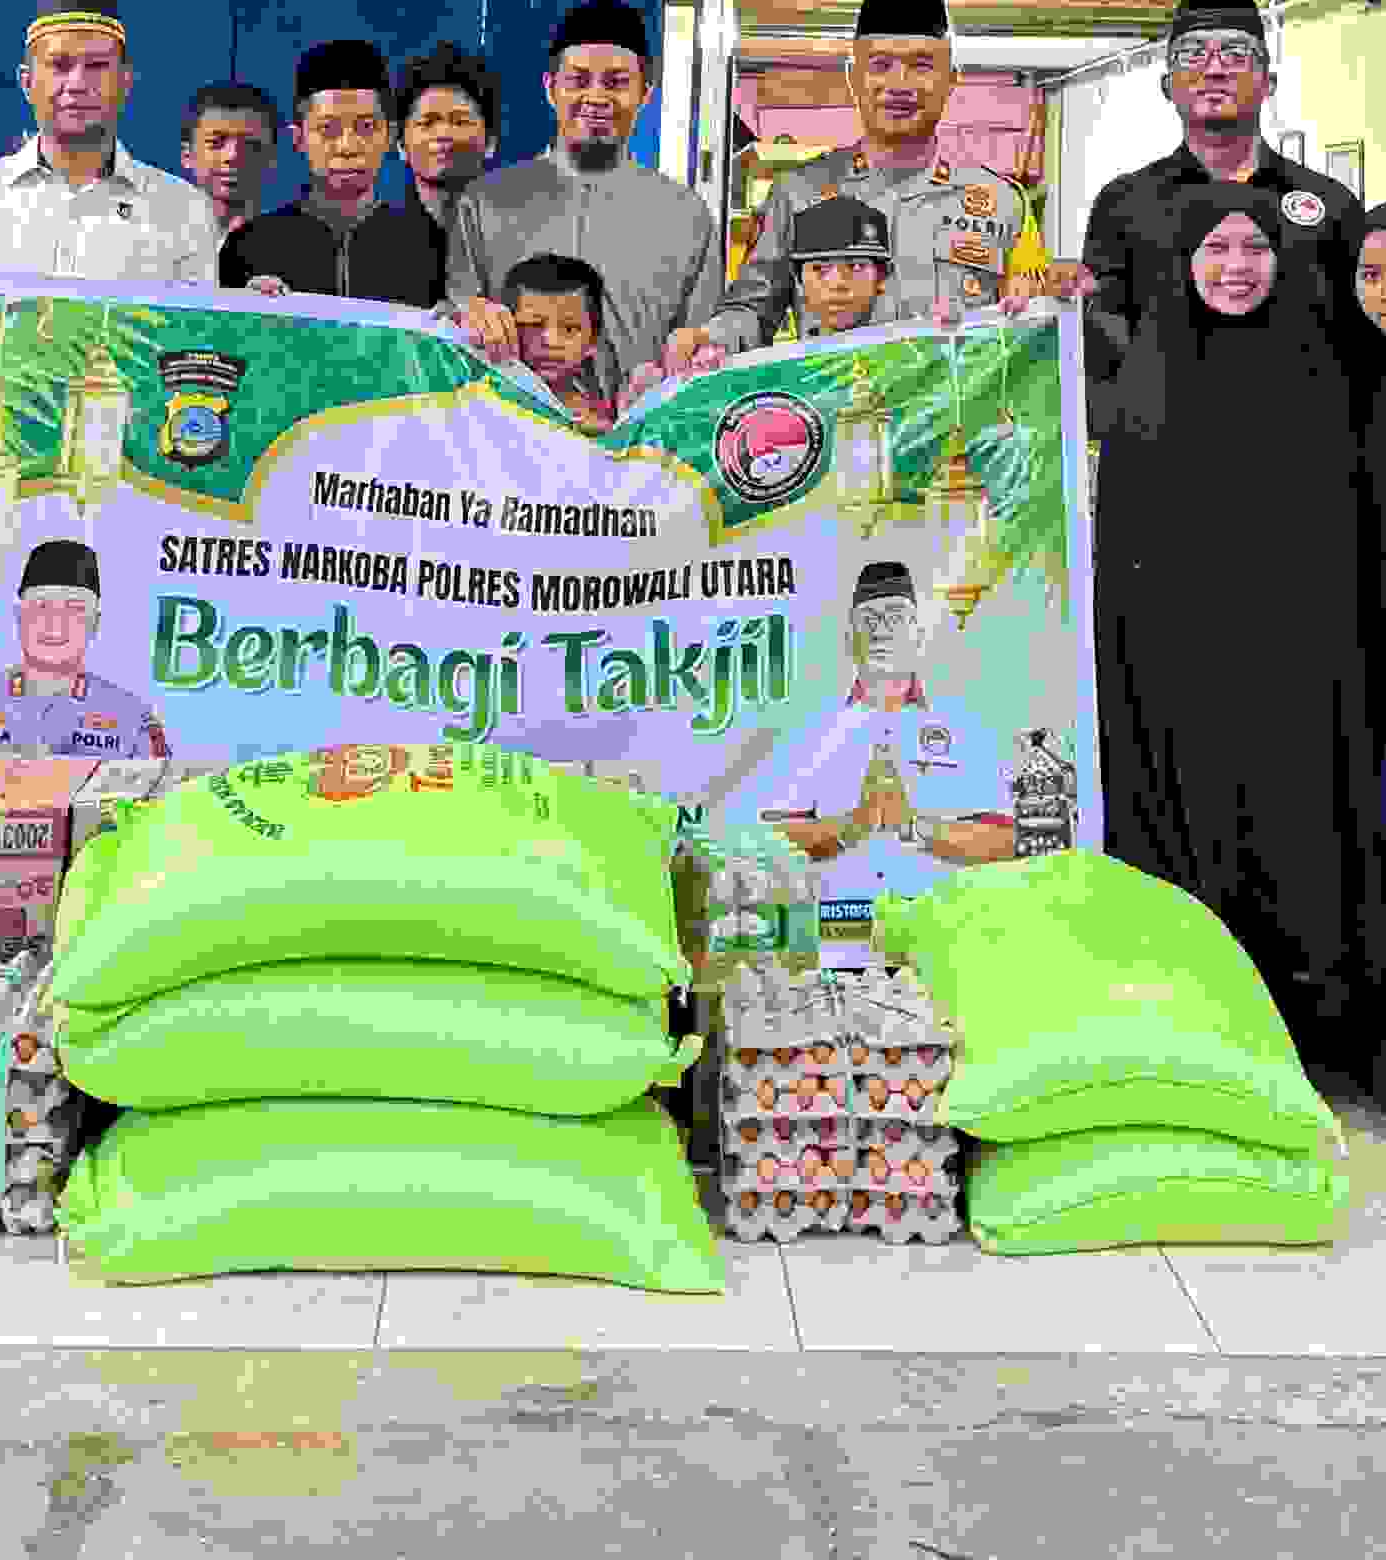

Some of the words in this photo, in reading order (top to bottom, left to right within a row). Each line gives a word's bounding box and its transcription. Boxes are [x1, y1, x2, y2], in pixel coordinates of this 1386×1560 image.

[312, 471, 451, 521] Marhaban
[460, 490, 493, 528] Ya
[501, 496, 659, 537] Ramadhan
[159, 535, 272, 577] SATRES
[279, 541, 408, 595] NARKOBA
[416, 559, 520, 608] POLRES
[531, 560, 692, 613] MOROWALI
[700, 555, 797, 599] UTARA
[152, 592, 527, 744] Berbagi
[541, 612, 793, 737] Takjil
[71, 730, 121, 752] POLRI
